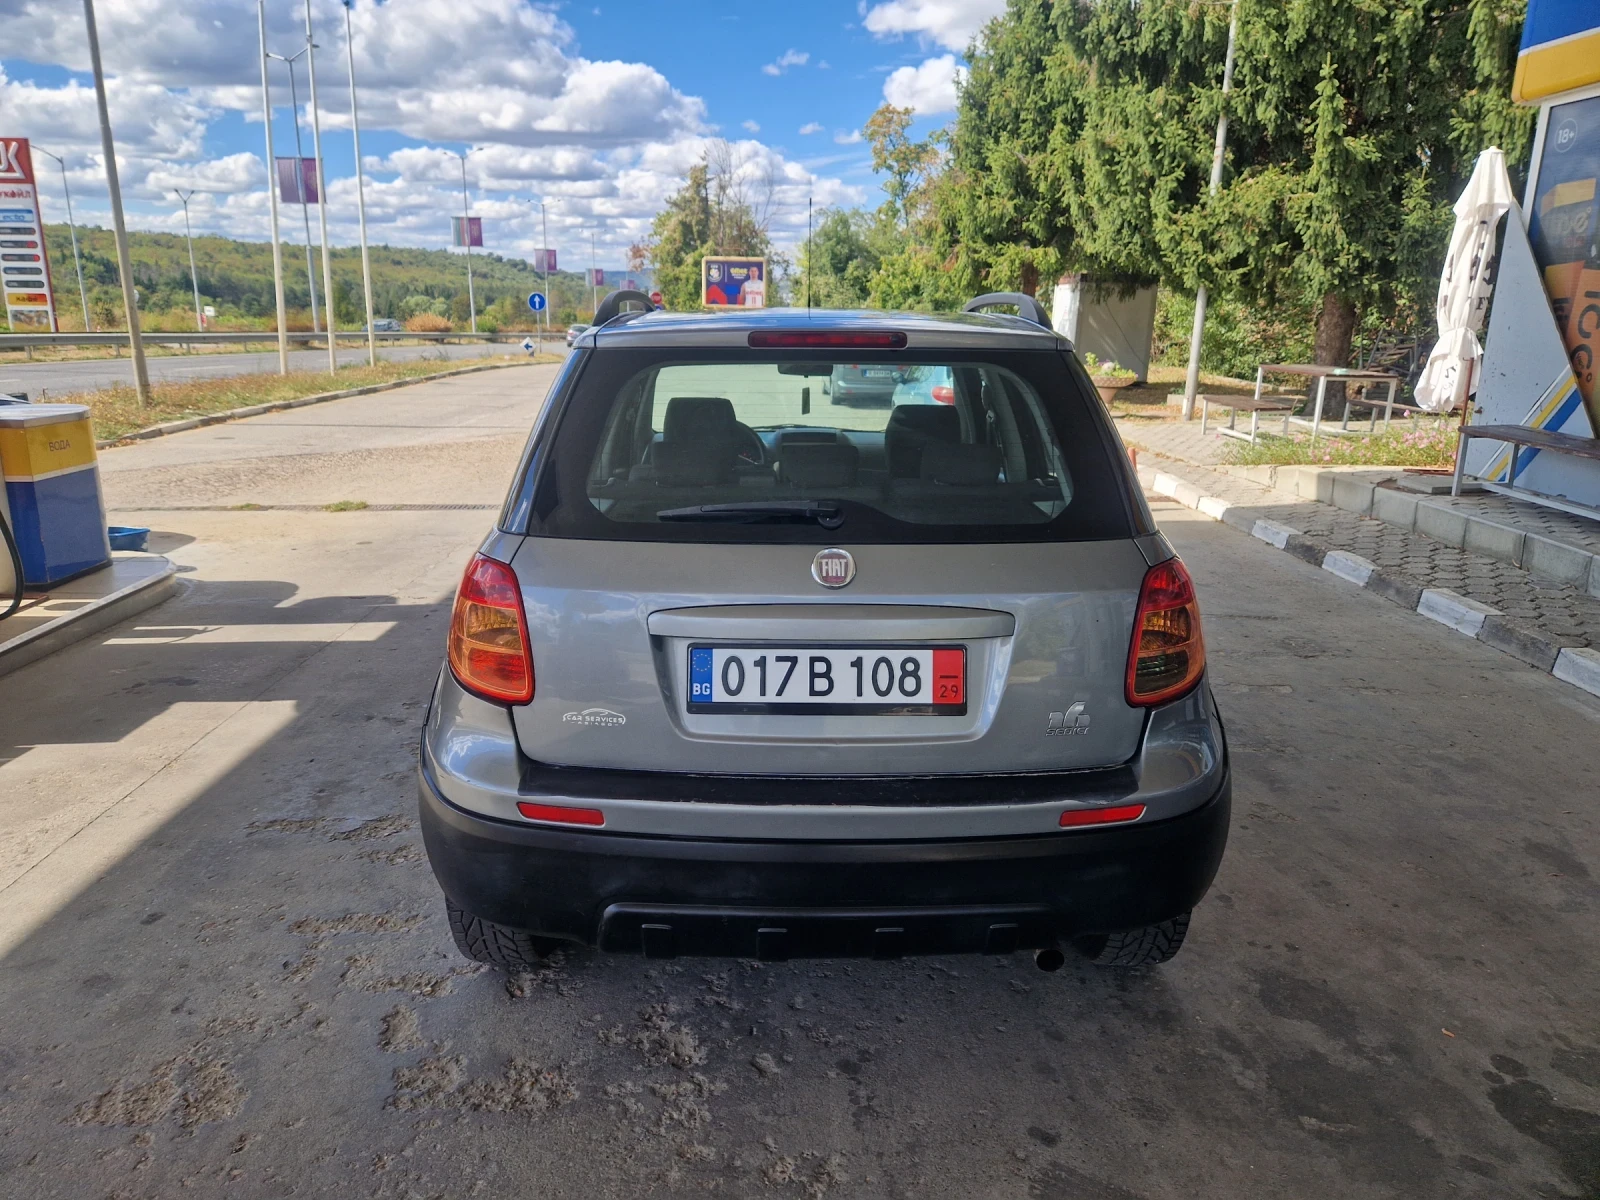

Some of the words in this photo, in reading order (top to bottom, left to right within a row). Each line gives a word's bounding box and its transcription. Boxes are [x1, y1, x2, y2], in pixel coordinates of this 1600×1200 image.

[1557, 128, 1575, 144] 18+
[49, 439, 71, 451] ВОДА
[820, 558, 847, 577] FIAT
[692, 683, 711, 696] BG
[940, 684, 958, 698] 29
